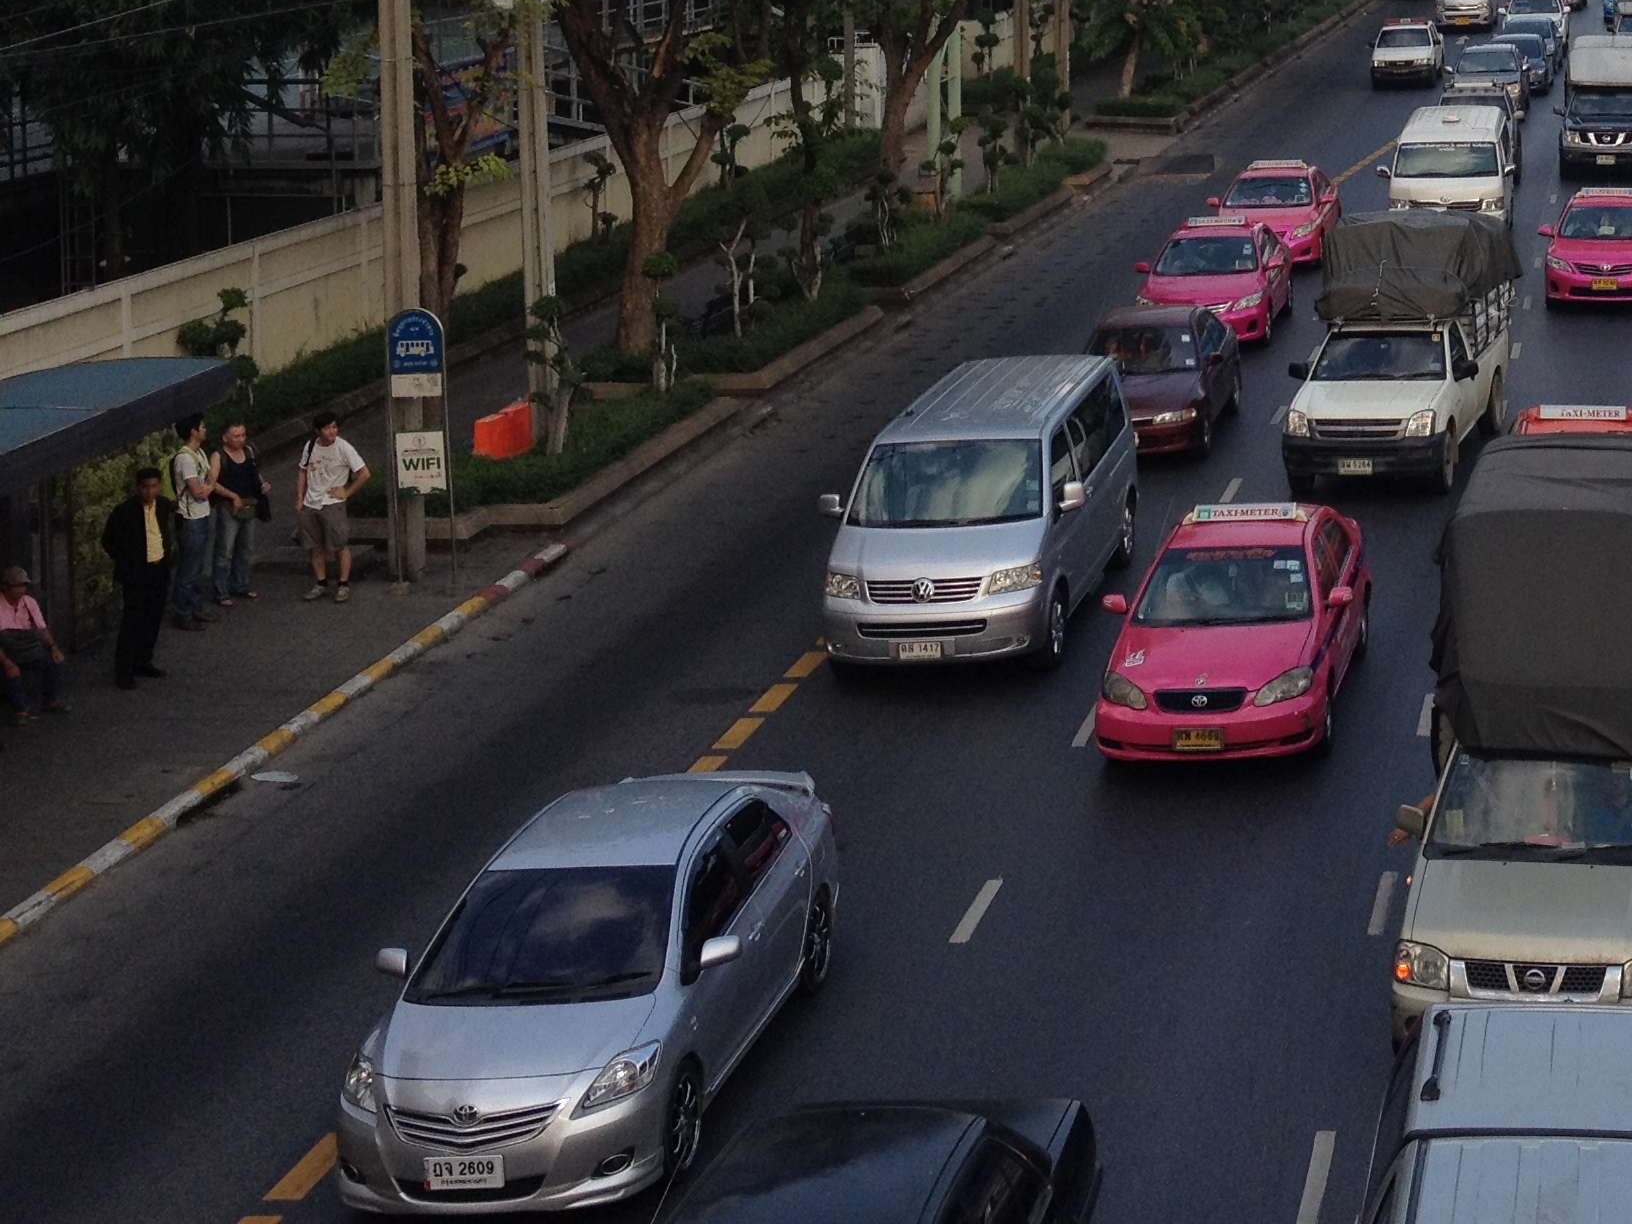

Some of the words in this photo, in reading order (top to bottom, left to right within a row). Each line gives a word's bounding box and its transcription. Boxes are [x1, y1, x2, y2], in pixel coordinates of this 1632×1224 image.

[402, 456, 441, 472] WIFI
[918, 643, 939, 653] 1417
[458, 1161, 495, 1177] 2609
